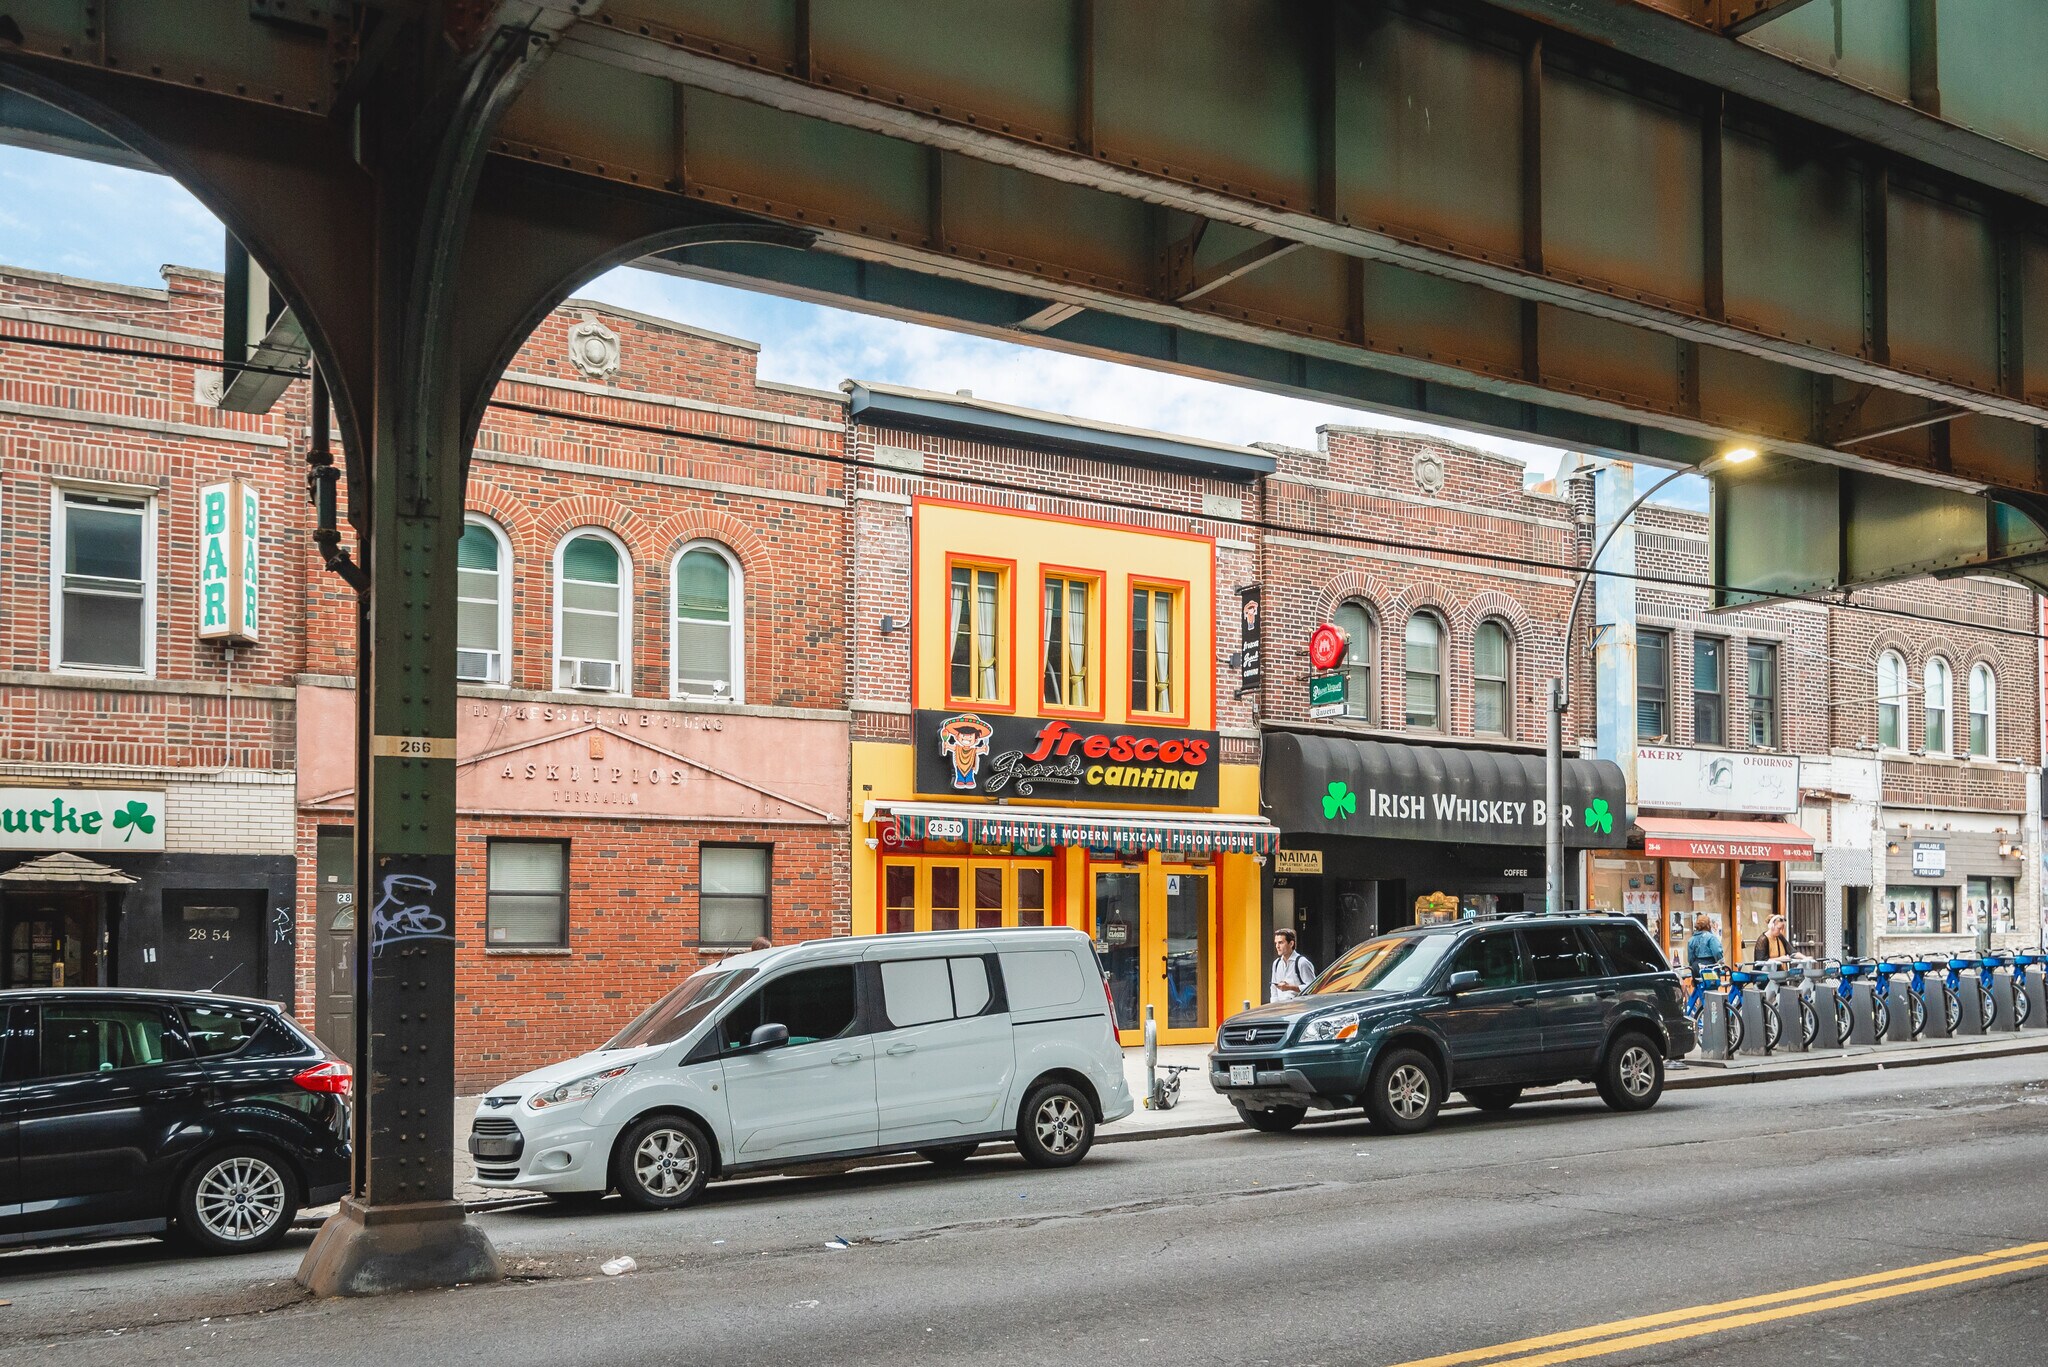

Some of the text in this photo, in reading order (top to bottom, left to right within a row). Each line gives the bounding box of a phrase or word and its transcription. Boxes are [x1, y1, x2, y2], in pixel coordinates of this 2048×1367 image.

[203, 491, 227, 627] BAR
[244, 494, 257, 630] BAR
[1315, 707, 1336, 717] Tavern
[400, 740, 432, 753] 266
[1024, 720, 1209, 766] fresco's
[1752, 758, 1793, 768] FOURNOS
[1085, 765, 1199, 790] cantina
[0, 797, 103, 834] urke
[1532, 799, 1575, 828] BR
[930, 823, 962, 834] 28-50
[981, 826, 1046, 838] AUTHENTIC
[1050, 828, 1058, 838] &
[1062, 828, 1109, 841] MODERN
[1113, 832, 1161, 843] MEXICAN
[1173, 834, 1211, 845] FUSION
[1214, 835, 1254, 847] CUISINE
[1690, 843, 1725, 855] YAYA'S
[1729, 844, 1772, 857] BAKERY
[1279, 852, 1318, 863] NAIMA
[1503, 869, 1528, 877] COFFEE
[1168, 878, 1178, 890] A
[338, 894, 351, 902] 28
[188, 928, 231, 941] 28 54
